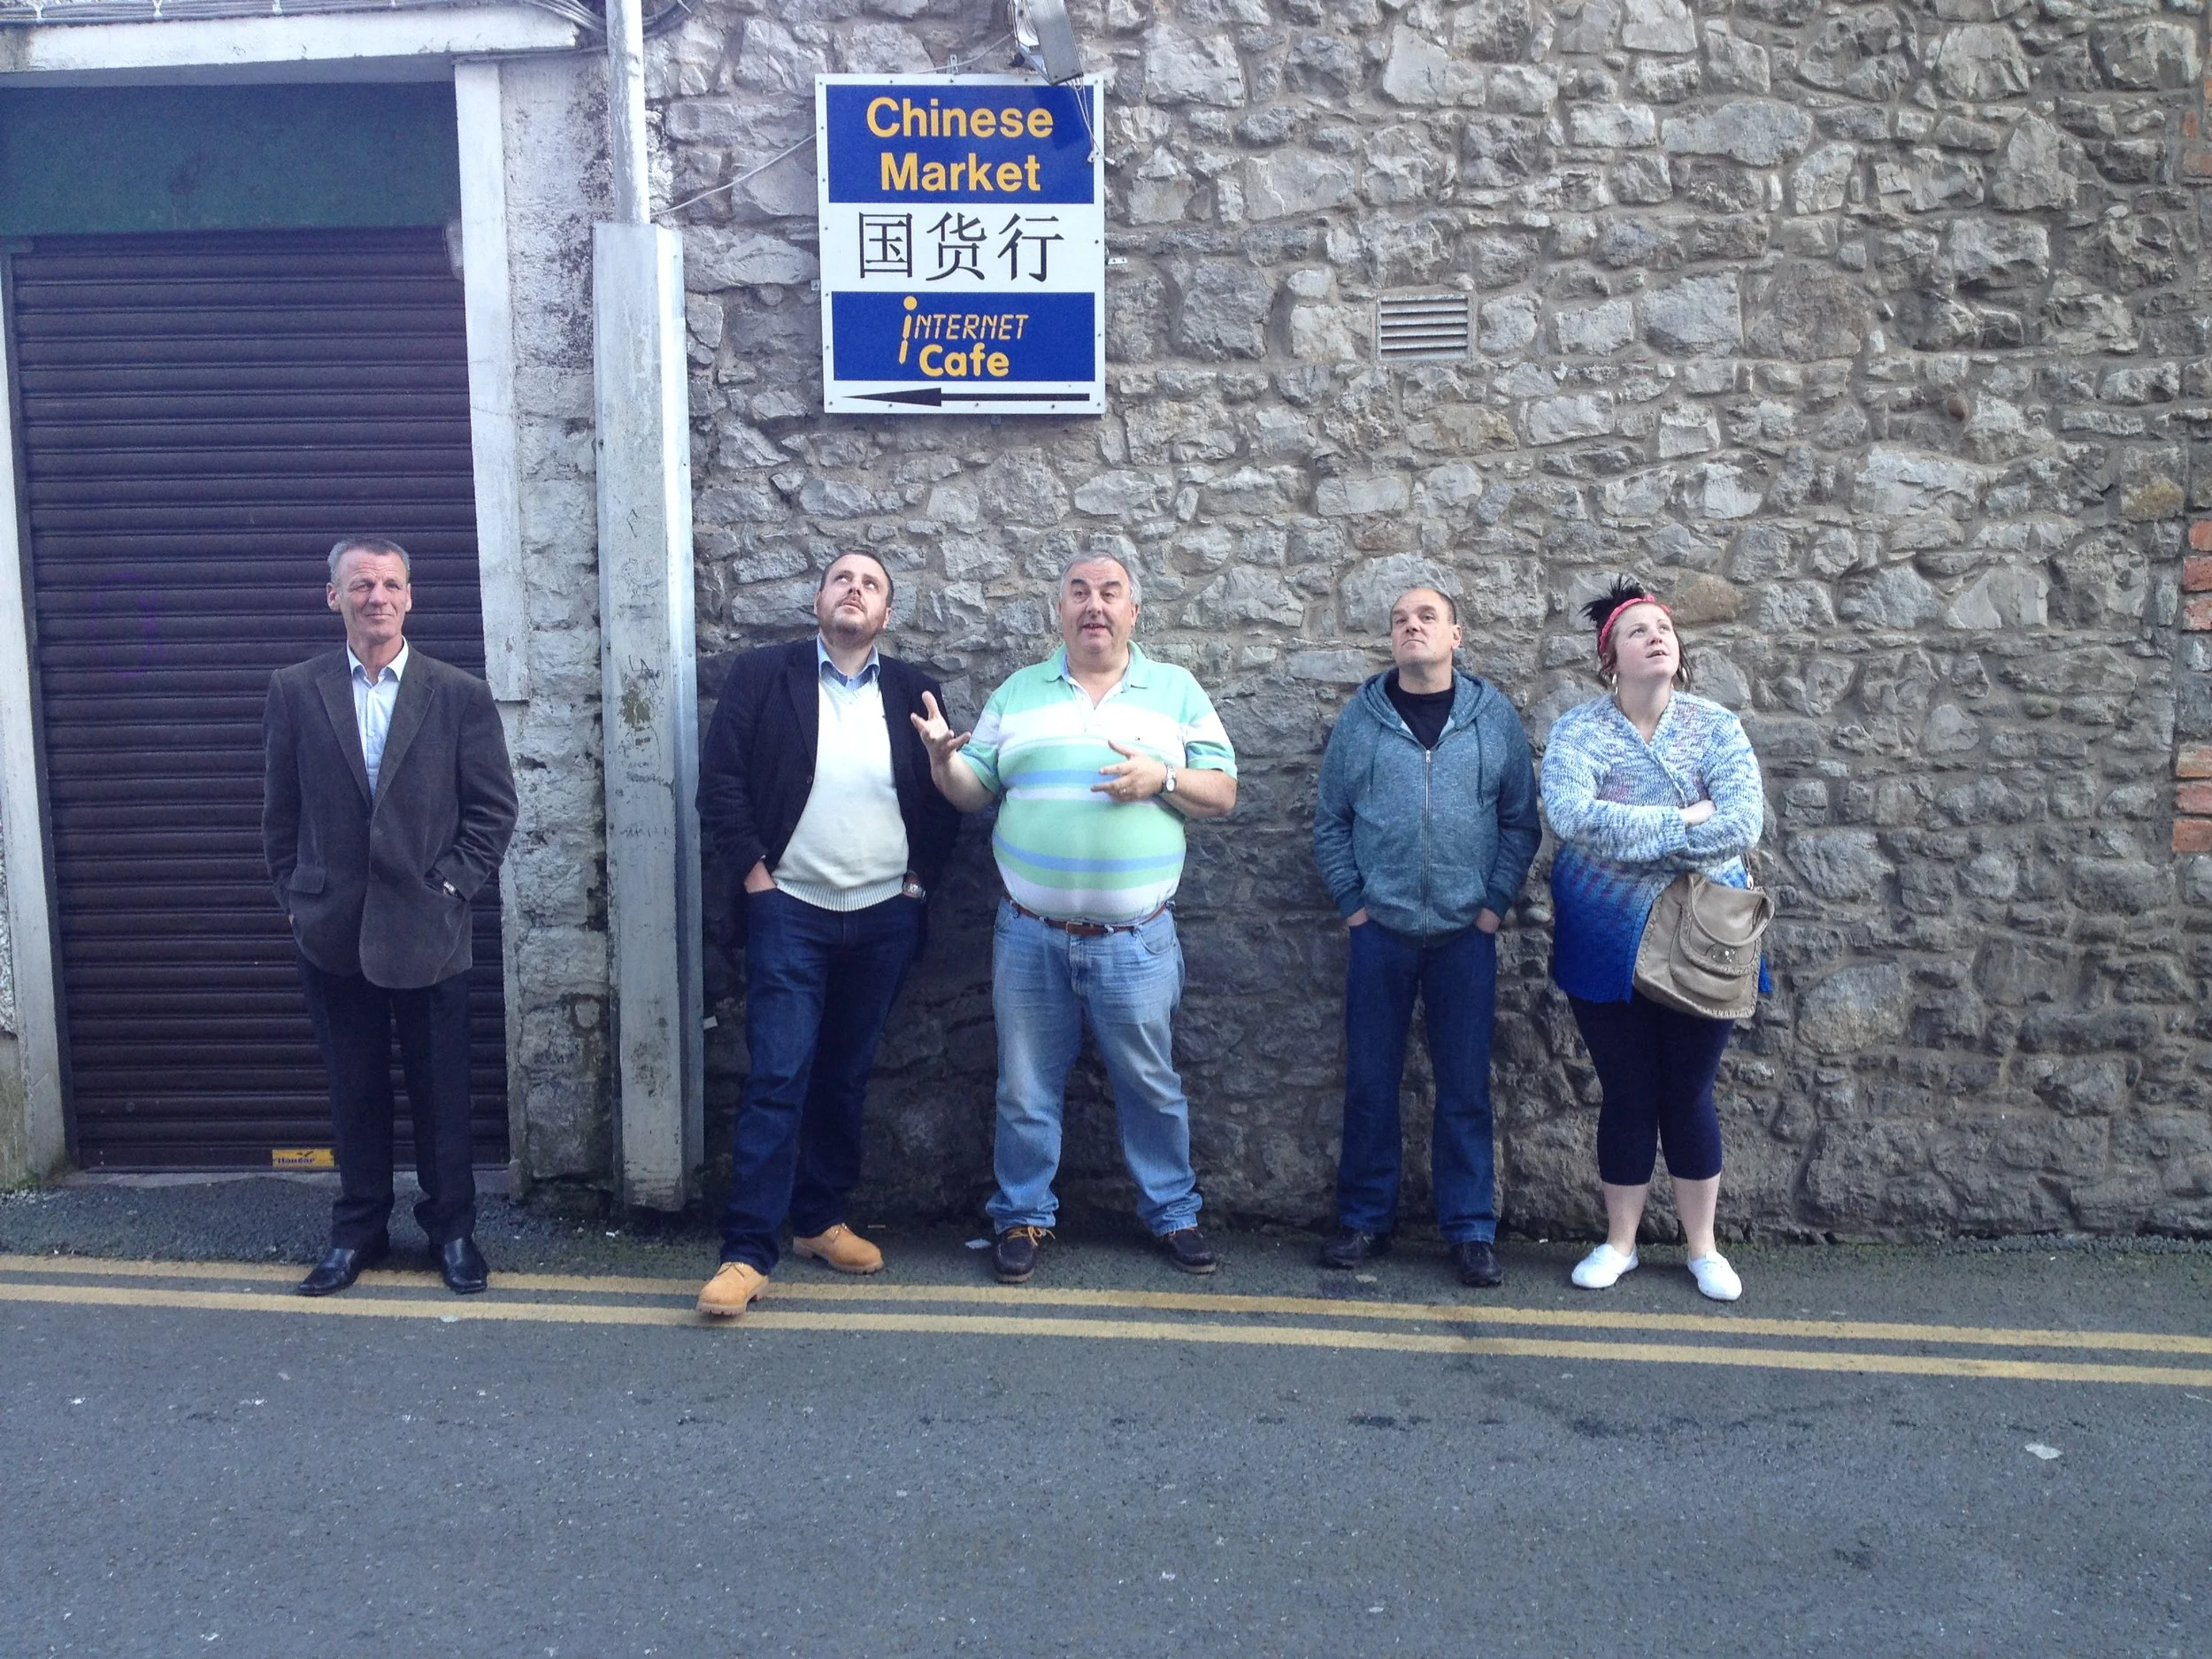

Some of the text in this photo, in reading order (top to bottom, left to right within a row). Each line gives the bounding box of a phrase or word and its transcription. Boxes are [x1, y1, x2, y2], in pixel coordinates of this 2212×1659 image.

[866, 97, 1053, 137] Chinese
[880, 152, 1041, 191] Market
[858, 211, 1064, 282] 国货行
[918, 342, 1010, 377] Cafe
